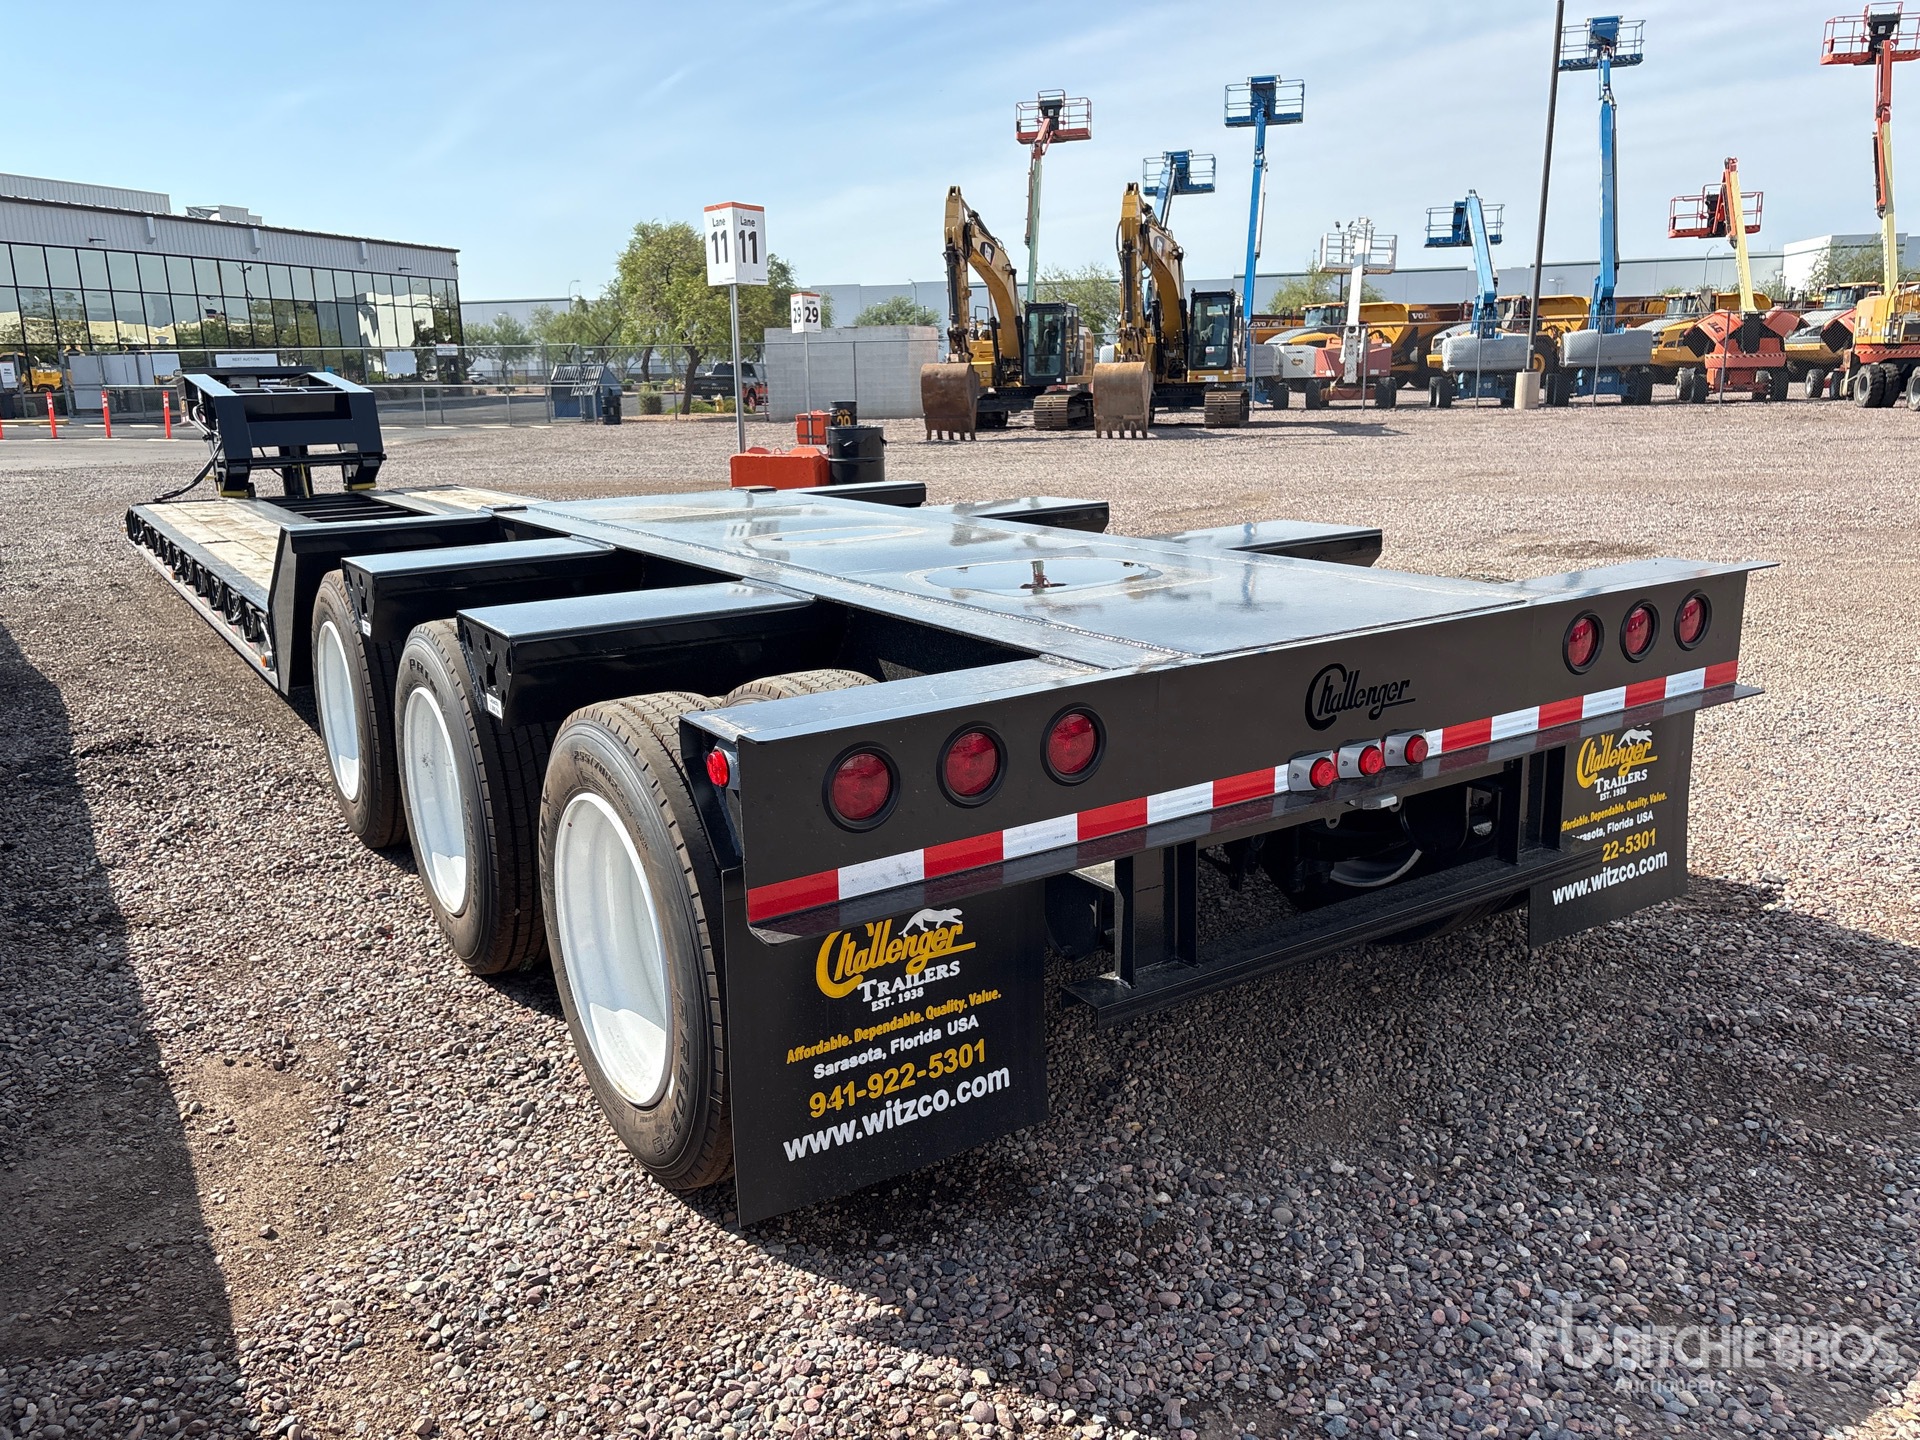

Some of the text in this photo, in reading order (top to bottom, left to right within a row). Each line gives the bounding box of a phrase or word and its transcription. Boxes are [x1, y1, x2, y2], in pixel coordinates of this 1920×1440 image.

[712, 217, 726, 228] Lane
[740, 215, 756, 227] Lane
[711, 230, 729, 265] 11
[738, 229, 758, 265] 11
[804, 306, 819, 323] 29
[1707, 321, 1725, 334] JLG
[1304, 663, 1416, 731] Challenger
[1577, 734, 1658, 789] Challenger
[1594, 769, 1648, 794] TRAILERS
[1599, 787, 1627, 801] EST. 1938
[1590, 803, 1626, 822] Dependable.
[1626, 796, 1649, 812] Quality.
[1649, 791, 1668, 804] Value.
[1607, 817, 1634, 835] Florida
[1636, 810, 1653, 825] USA
[1602, 828, 1657, 862] 22-5301
[1552, 851, 1668, 905] www.witzco.com
[816, 918, 977, 999] Challenger
[857, 960, 961, 1003] TRAILERS
[871, 987, 925, 1012] EST. 1938
[786, 990, 1002, 1064] Affordable. Dependable. Quality. Value.
[813, 1014, 980, 1079] Sarasota, Florida USA
[809, 1038, 986, 1119] 941-922-5301
[783, 1067, 1011, 1162] www.witzco.com
